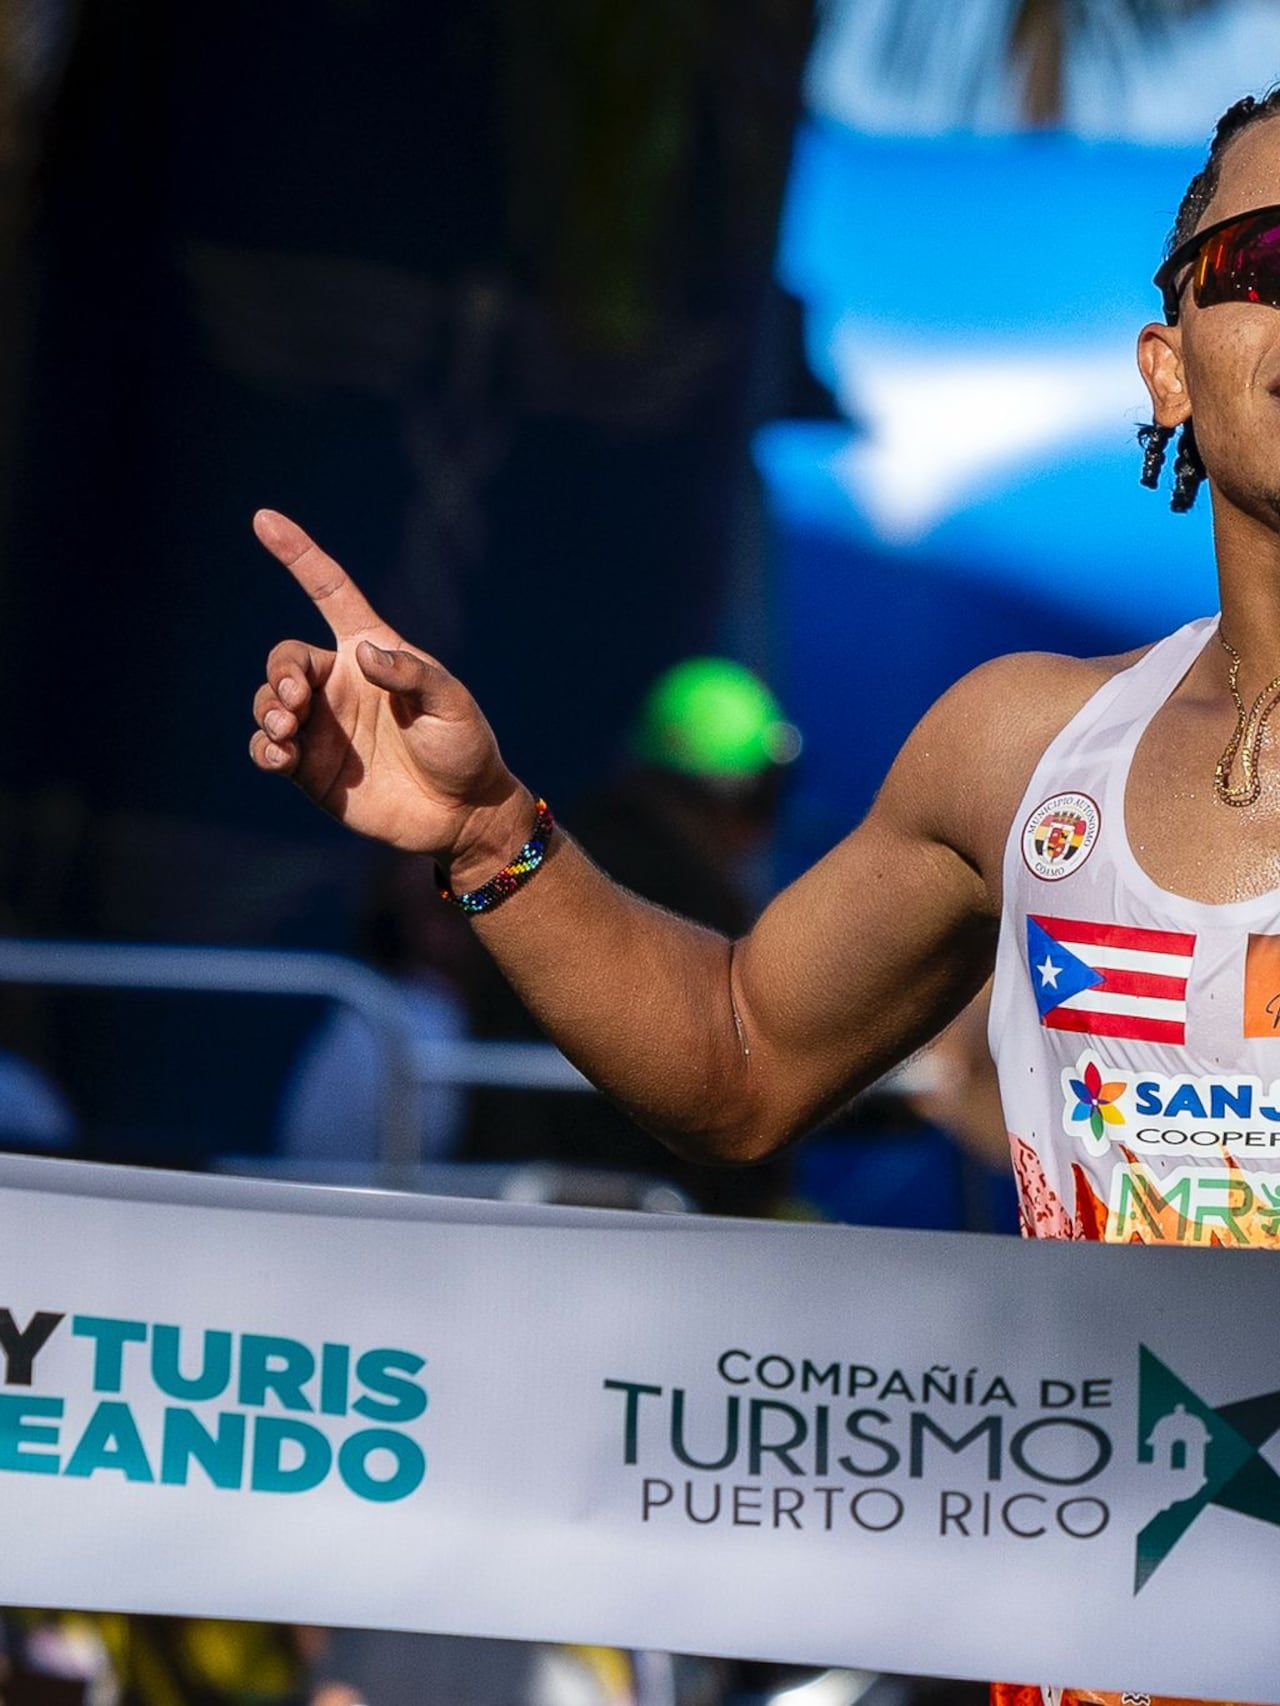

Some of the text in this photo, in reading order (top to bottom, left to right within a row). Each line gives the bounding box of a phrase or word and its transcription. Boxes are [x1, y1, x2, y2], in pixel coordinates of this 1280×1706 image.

[1027, 796, 1073, 834] MUNICIPIO
[1034, 862, 1065, 877] COAMO
[1135, 1081, 1253, 1120] SAN
[717, 1347, 1113, 1409] COMPAÑÍA DE
[604, 1378, 1112, 1486] TURISMO
[642, 1478, 1110, 1539] PUERTO RICO
